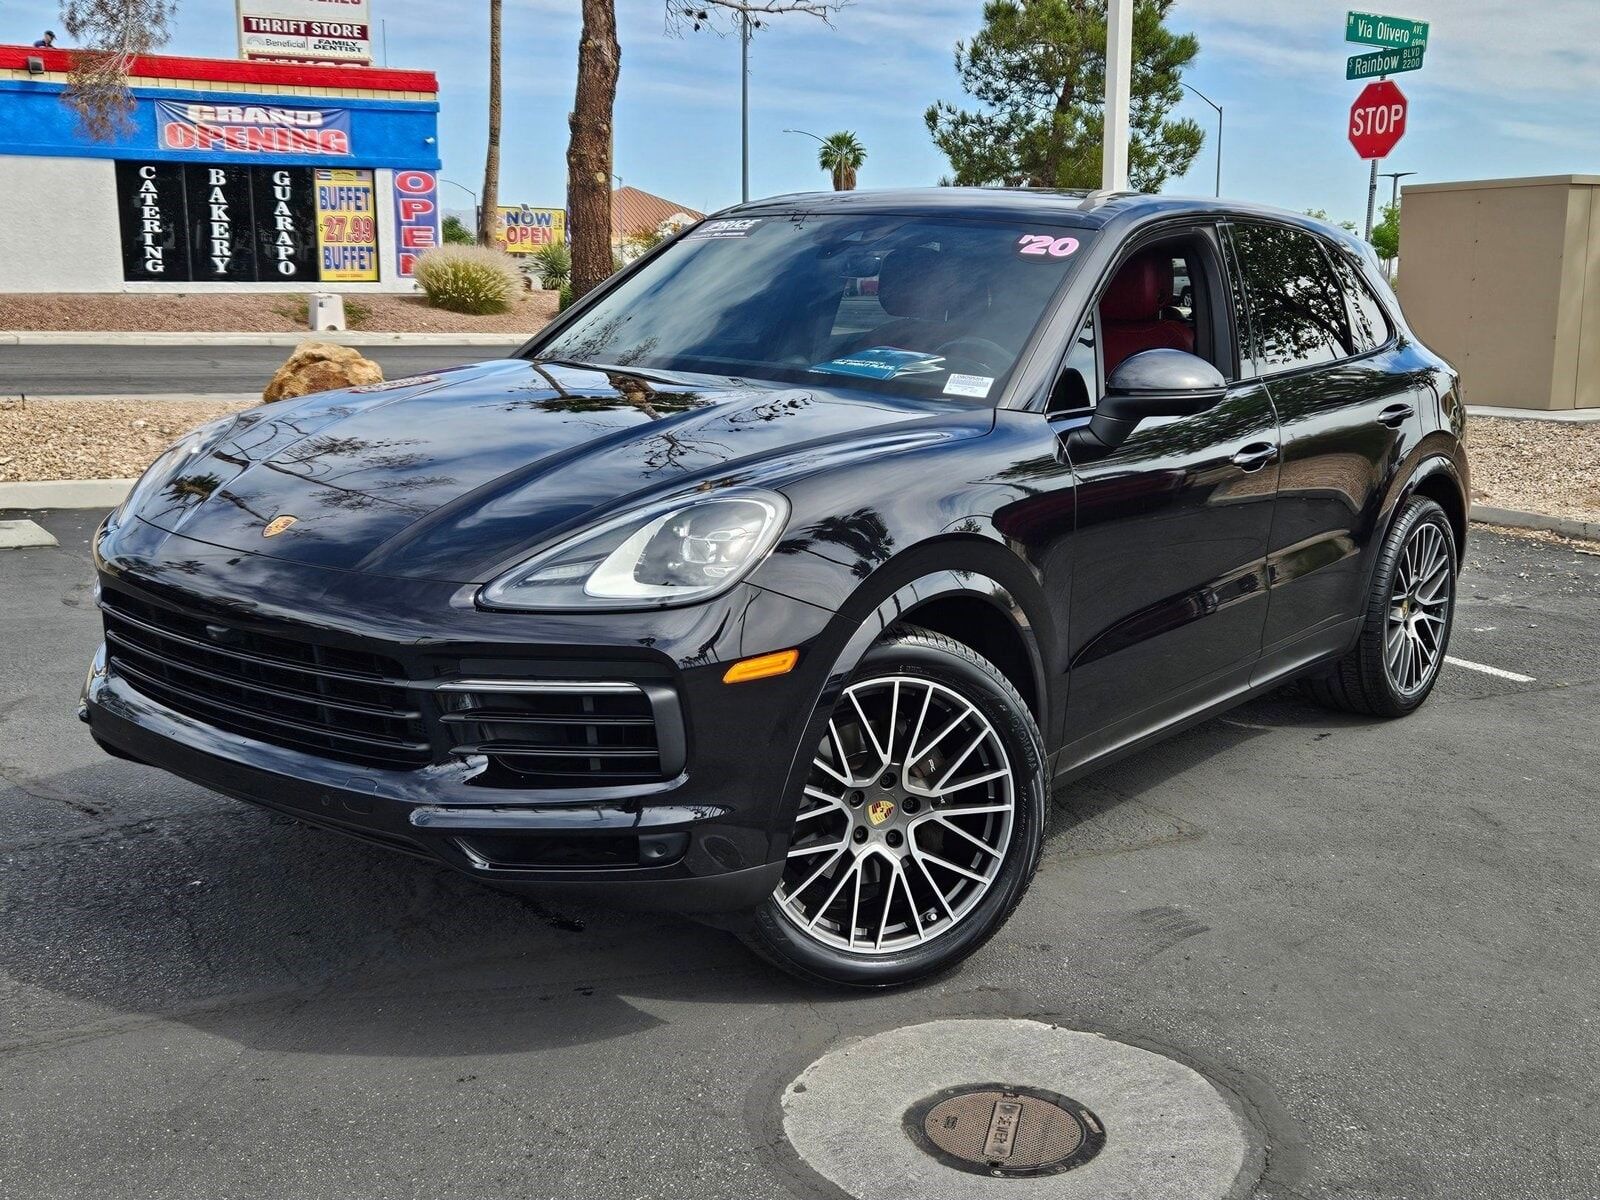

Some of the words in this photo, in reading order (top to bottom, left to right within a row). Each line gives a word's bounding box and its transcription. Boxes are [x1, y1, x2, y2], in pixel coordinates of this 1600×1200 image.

[248, 18, 307, 33] THRIFT
[311, 22, 363, 37] STORE
[1358, 19, 1373, 38] Via
[1377, 22, 1409, 43] Olivero
[1412, 25, 1423, 35] AVE
[265, 38, 306, 49] Beneficial
[313, 44, 362, 53] DENTIST
[318, 39, 358, 47] FAMILY
[1349, 58, 1354, 68] S
[1355, 54, 1400, 75] Rainbow
[1402, 47, 1420, 59] BLVD
[1402, 58, 1420, 69] 2200
[187, 104, 324, 127] GRAND
[1352, 104, 1404, 136] STOP
[164, 121, 349, 155] OPENING
[319, 186, 371, 212] BUFFET
[139, 166, 165, 273] CATERING
[208, 168, 232, 274] BAKERY
[272, 171, 297, 275] GUARAPO
[506, 211, 552, 227] NOW
[506, 226, 553, 246] OPEN
[323, 245, 375, 271] BUFFET
